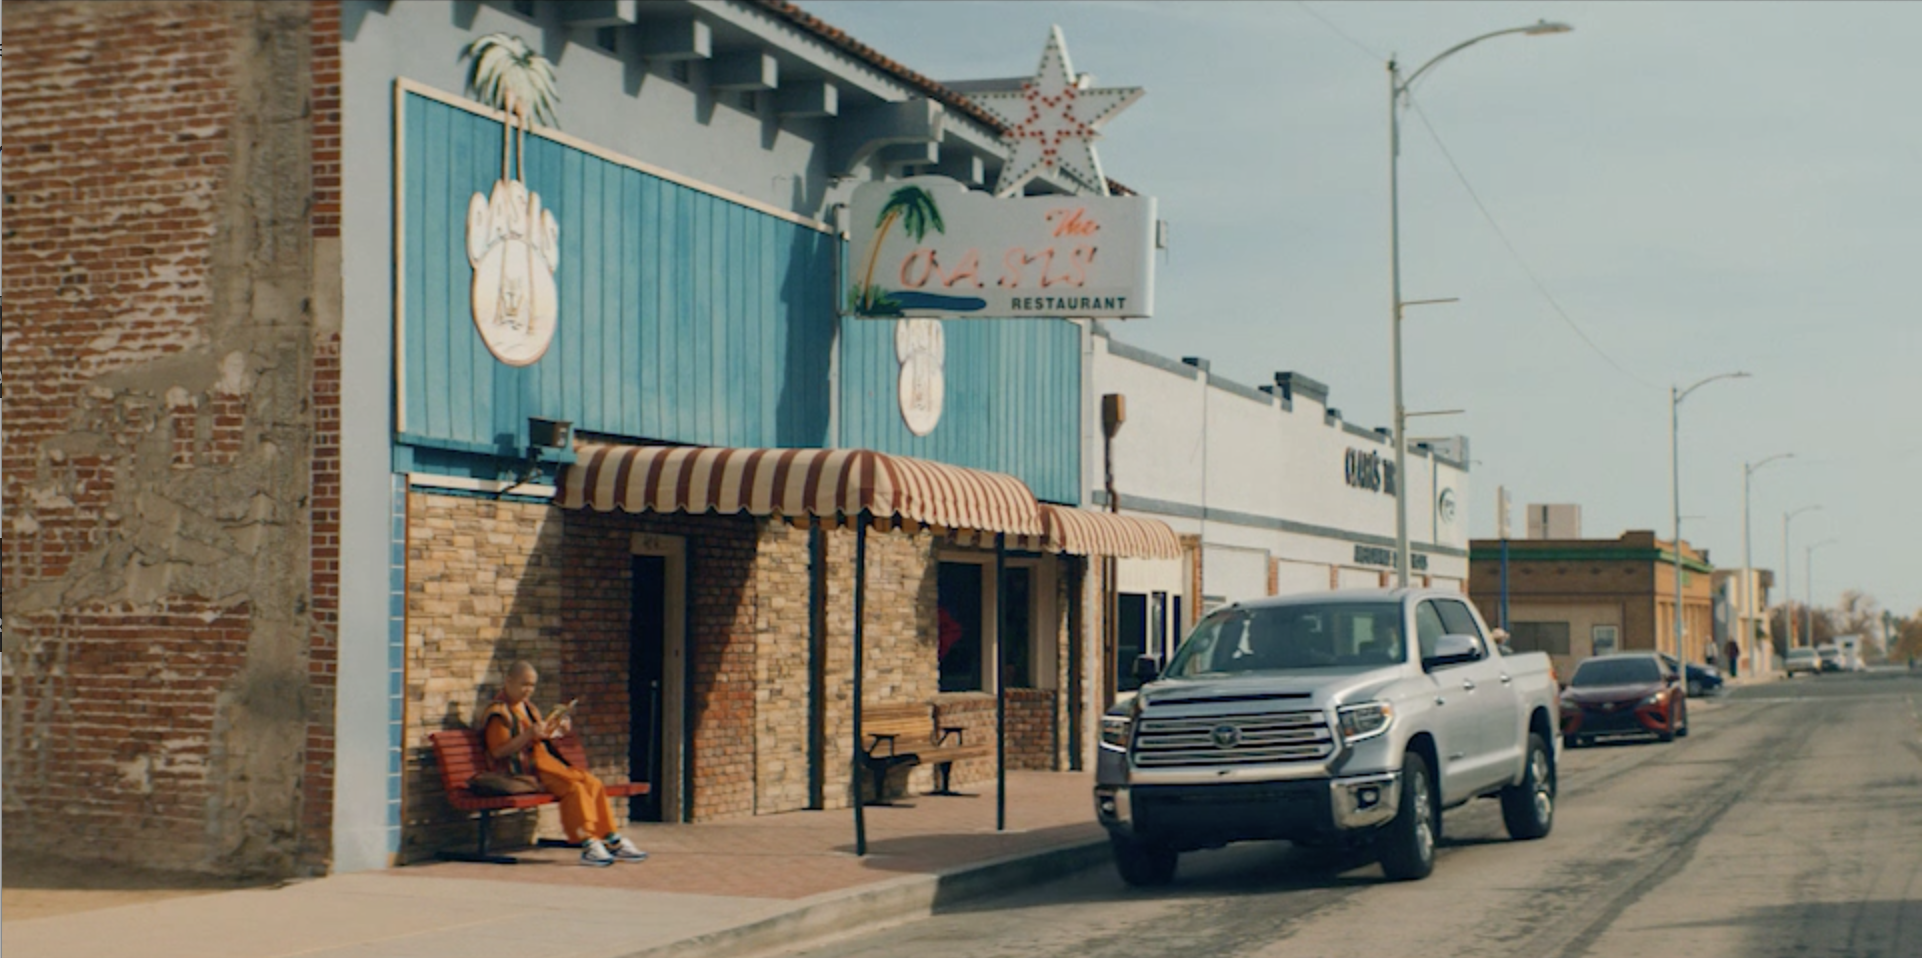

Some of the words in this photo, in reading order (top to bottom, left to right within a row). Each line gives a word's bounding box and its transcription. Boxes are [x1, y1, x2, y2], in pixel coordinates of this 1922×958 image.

[1045, 207, 1100, 237] The
[899, 246, 1098, 288] OASIS
[1011, 296, 1127, 311] RESTAURANT
